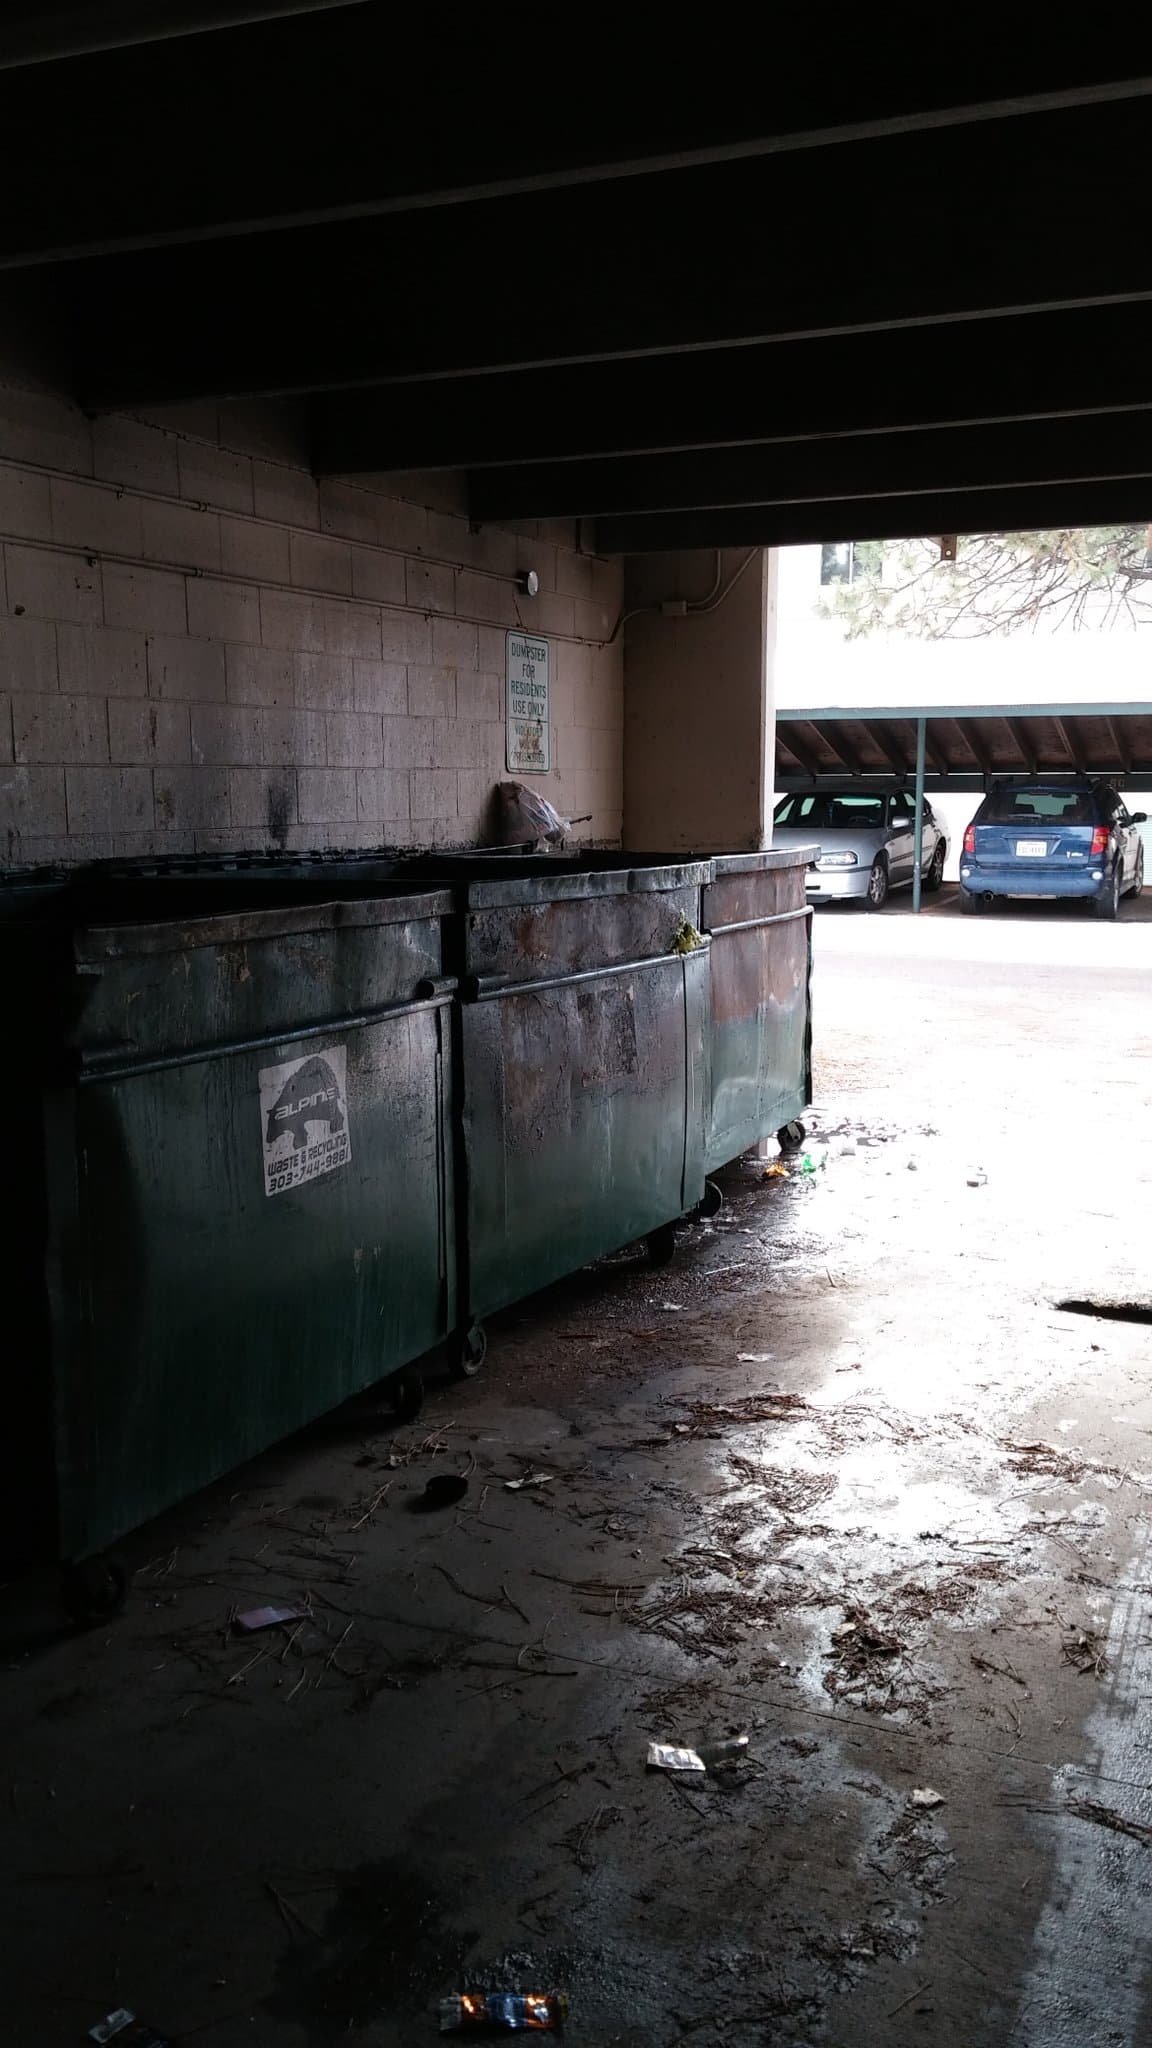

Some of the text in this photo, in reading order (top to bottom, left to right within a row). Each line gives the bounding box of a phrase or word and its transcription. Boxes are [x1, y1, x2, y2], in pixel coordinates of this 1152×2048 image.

[511, 642, 546, 663] DUMPSTER
[522, 663, 535, 679] FOR
[511, 680, 546, 699] RESIDENTS
[512, 699, 545, 716] USE ONLY
[307, 1132, 347, 1160] RECYCLING
[268, 1144, 349, 1193] 303-744-9881
